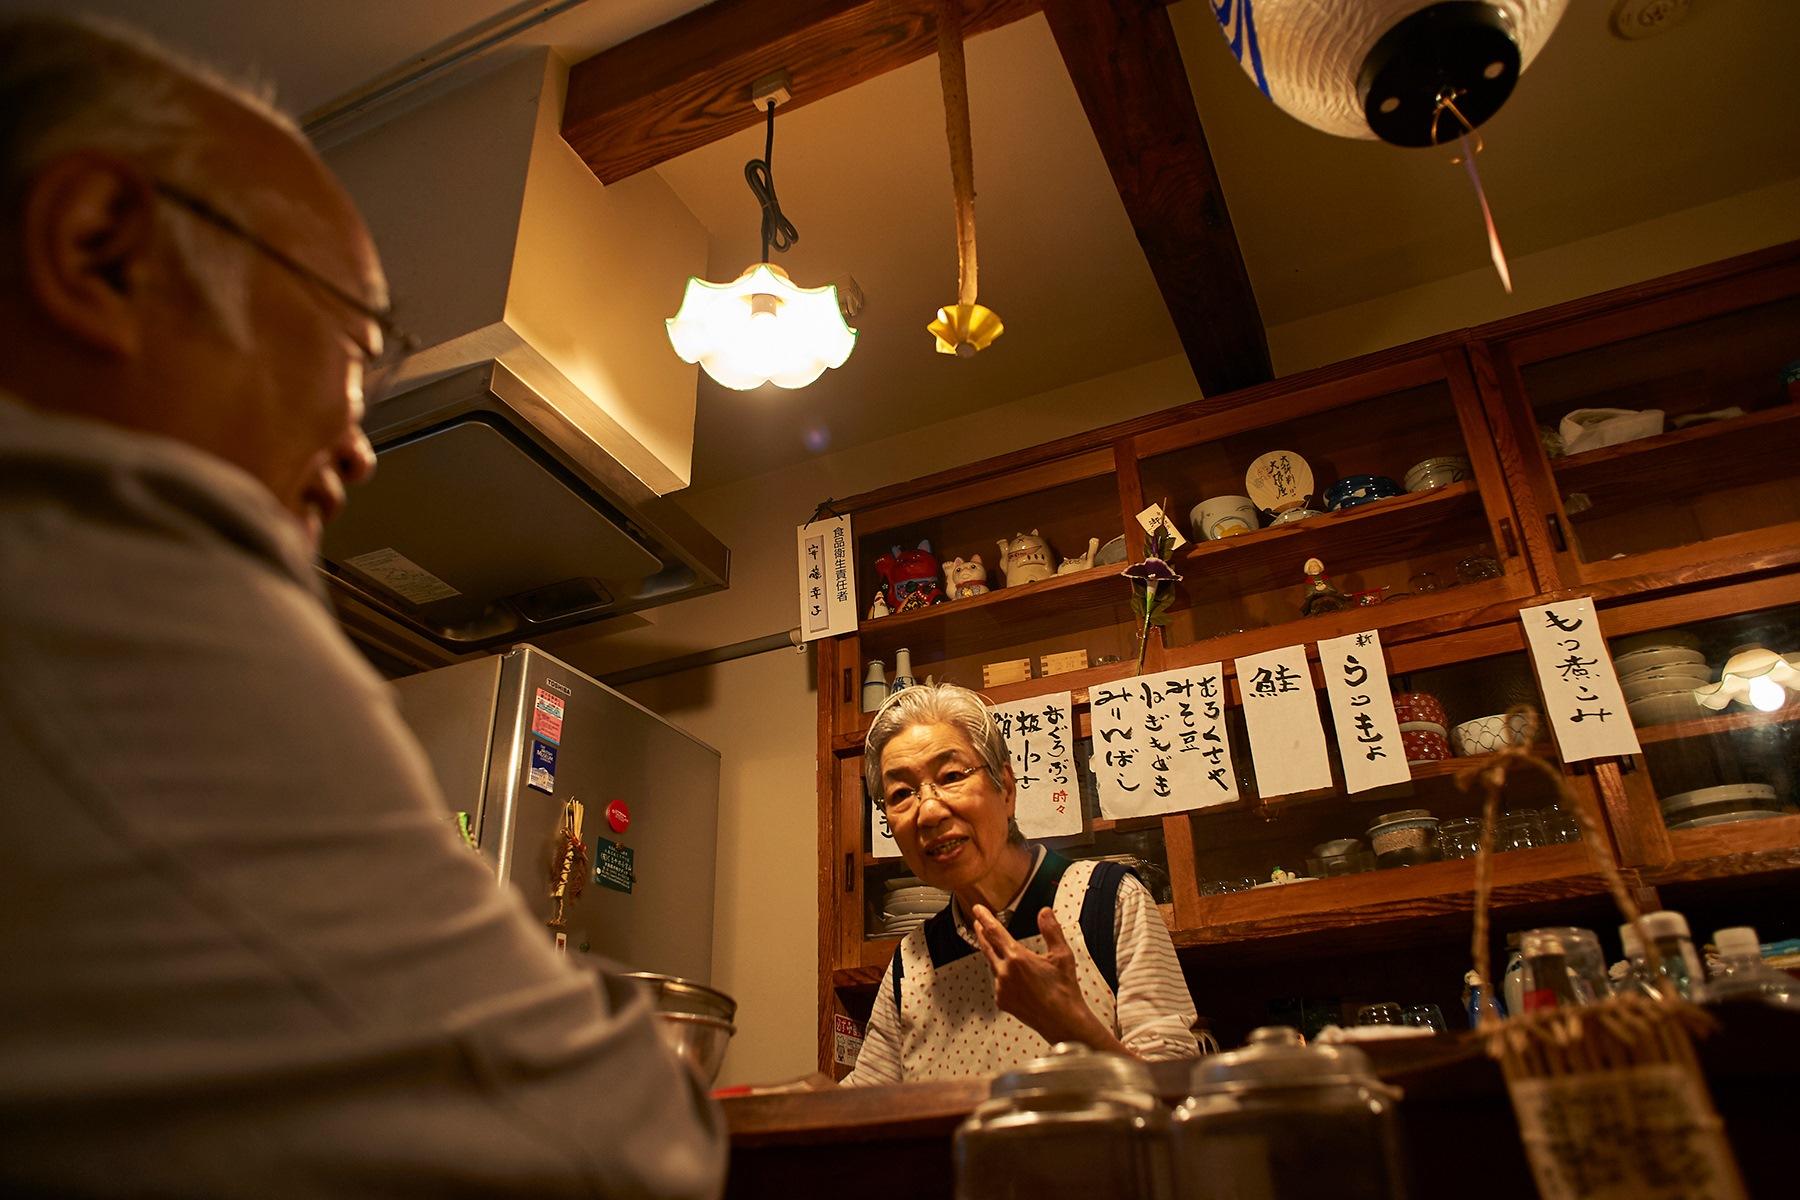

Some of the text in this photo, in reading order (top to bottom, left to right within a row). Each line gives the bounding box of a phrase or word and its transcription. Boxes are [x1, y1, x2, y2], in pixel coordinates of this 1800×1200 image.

[832, 526, 848, 602] 食品衛生責任者
[547, 678, 571, 696] TOSHIBA
[1249, 664, 1302, 698] 鮭
[1093, 686, 1141, 792] みりんぼし
[1165, 678, 1200, 753] みそ豆
[1052, 789, 1069, 815] 時々
